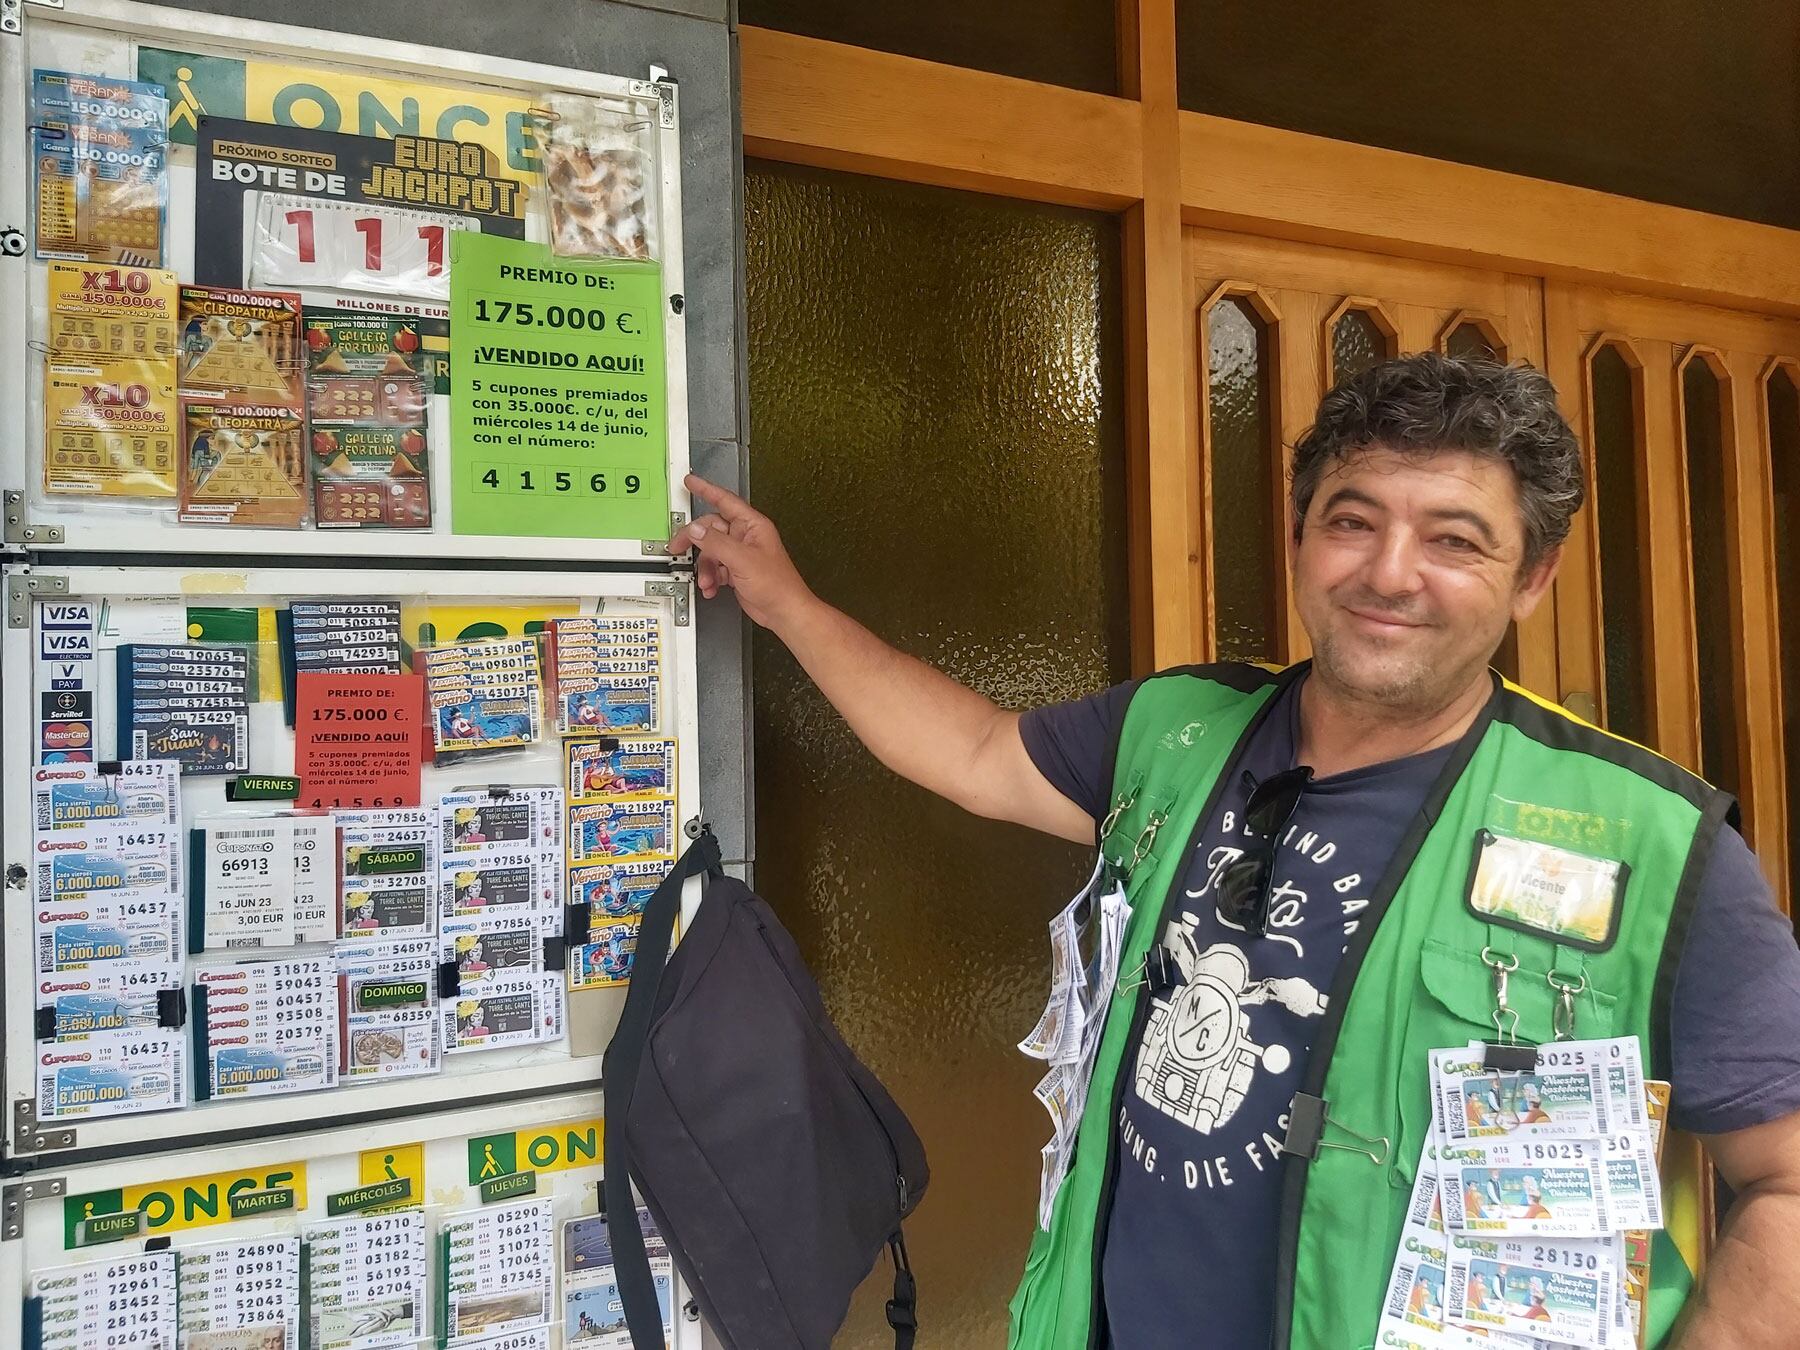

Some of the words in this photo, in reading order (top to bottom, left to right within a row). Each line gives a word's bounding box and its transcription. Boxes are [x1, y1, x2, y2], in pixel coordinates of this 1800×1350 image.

[218, 144, 277, 160] PRÓXIMO
[282, 153, 332, 167] SORTEO
[395, 137, 481, 177] EURO
[212, 160, 297, 189] BOTE
[305, 171, 346, 195] DE
[362, 166, 515, 213] JACKPOT
[81, 270, 151, 294] x10
[500, 265, 578, 285] PREMIO
[585, 276, 614, 290] DE:
[82, 293, 165, 309] 150.000€
[226, 294, 281, 308] 100.000€
[336, 299, 400, 312] MILLONES
[404, 306, 420, 314] DE
[203, 302, 275, 320] CLEOPATRA
[475, 300, 606, 331] 175.000
[616, 313, 641, 334] €.
[338, 331, 387, 342] GALLETA
[339, 343, 389, 353] FORTUNA
[474, 347, 579, 368] ¡VENDIDO
[586, 355, 644, 372] AQUÍ!
[81, 384, 151, 408] x10
[472, 380, 481, 391] 5
[490, 383, 558, 397] cupones
[565, 388, 648, 402] premiados
[232, 407, 287, 417] 100.000€
[472, 400, 501, 410] con
[508, 400, 579, 415] 35.000€.
[586, 407, 619, 419] c/u,
[626, 407, 647, 419] del
[210, 417, 281, 428] CLEOPATRA
[473, 415, 553, 430] miércoles
[558, 420, 576, 432] 14
[581, 421, 599, 432] de
[604, 423, 648, 437] junio,
[345, 434, 394, 444] GALLETA
[473, 433, 502, 444] con
[507, 434, 522, 445] el
[528, 435, 595, 449] número:
[345, 445, 396, 455] FORTUNA
[482, 469, 499, 488] 4
[520, 471, 535, 490] 1
[555, 473, 571, 491] 5
[590, 474, 606, 492] 6
[625, 475, 640, 493] 9
[47, 607, 89, 620] VISA
[612, 621, 645, 630] 35865
[47, 636, 89, 649] VISA
[344, 631, 384, 642] 67502
[613, 635, 646, 643] 71056
[345, 648, 384, 659] 74293
[484, 644, 521, 656] 53780
[612, 648, 645, 657] 67427
[60, 664, 75, 677] V
[187, 665, 230, 676] 23576
[486, 658, 523, 670] 09801
[613, 662, 646, 672] 92718
[59, 680, 75, 688] PAY
[487, 673, 524, 684] 21892
[614, 678, 647, 688] 84349
[185, 682, 228, 693] 01847
[488, 687, 525, 699] 43073
[190, 712, 232, 723] 75429
[312, 709, 387, 721] 175.000
[394, 709, 408, 720] €.
[45, 732, 89, 740] MasterCard
[170, 728, 200, 740] San
[311, 734, 370, 743] ¡VENDIDO
[375, 732, 408, 741] AQUÍ!
[628, 743, 662, 753] 21892
[244, 780, 294, 790] VIERNES
[312, 799, 321, 808] 4
[628, 803, 662, 813] 21892
[55, 804, 118, 819] 6.000.000
[387, 813, 426, 823] 97856
[118, 833, 166, 846] 16437
[387, 831, 426, 842] 24637
[217, 842, 274, 853] CUPONAZO
[222, 857, 269, 872] 66913
[367, 853, 415, 865] SÁBADO
[494, 854, 530, 866] 97856
[628, 863, 662, 874] 21892
[56, 875, 120, 890] 6.000.000
[387, 876, 426, 888] 32708
[1520, 874, 1566, 895] Vicente
[120, 902, 166, 916] 16437
[219, 900, 232, 908] 16
[234, 899, 256, 908] JUN
[259, 898, 272, 906] 23
[238, 916, 260, 925] 3,00
[263, 915, 283, 923] EUR
[495, 917, 531, 929] 97856
[58, 944, 121, 961] 6.000.000
[392, 942, 431, 955] 54897
[274, 963, 319, 976] 31872
[393, 960, 431, 972] 25638
[120, 972, 168, 986] 16437
[275, 977, 321, 990] 59043
[364, 984, 424, 998] DOMINGO
[496, 981, 532, 994] 97856
[276, 992, 322, 1006] 60457
[276, 1008, 322, 1022] 93508
[394, 1010, 432, 1022] 68359
[276, 1026, 322, 1040] 20379
[121, 1042, 169, 1056] 16437
[59, 1087, 123, 1104] 6.000.000
[527, 1127, 596, 1168] ON
[1523, 1144, 1584, 1159] 18025
[1184, 1156, 1234, 1189] DIE
[489, 1176, 528, 1195] JUEVES
[237, 1193, 287, 1210] MARTES
[337, 1183, 403, 1207] MIÉRCOLES
[497, 1207, 539, 1223] 05290
[93, 1217, 136, 1233] LUNES
[366, 1218, 409, 1232] 86710
[498, 1222, 538, 1239] 78621
[366, 1233, 409, 1249] 74231
[498, 1238, 539, 1255] 31072
[238, 1243, 284, 1258] 24890
[365, 1250, 409, 1265] 03182
[1471, 1249, 1497, 1259] DIARIO
[500, 1252, 539, 1269] 17064
[1534, 1246, 1597, 1270] 28130
[107, 1261, 158, 1278] 65980
[236, 1261, 282, 1275] 05981
[366, 1265, 410, 1281] 56193
[501, 1268, 542, 1284] 87345
[109, 1277, 159, 1295] 72961
[235, 1278, 282, 1293] 43952
[367, 1281, 411, 1296] 62704
[109, 1295, 159, 1311] 83452
[236, 1295, 283, 1309] 52043
[107, 1311, 158, 1329] 28143
[238, 1309, 284, 1323] 73864
[107, 1328, 159, 1346] 02674
